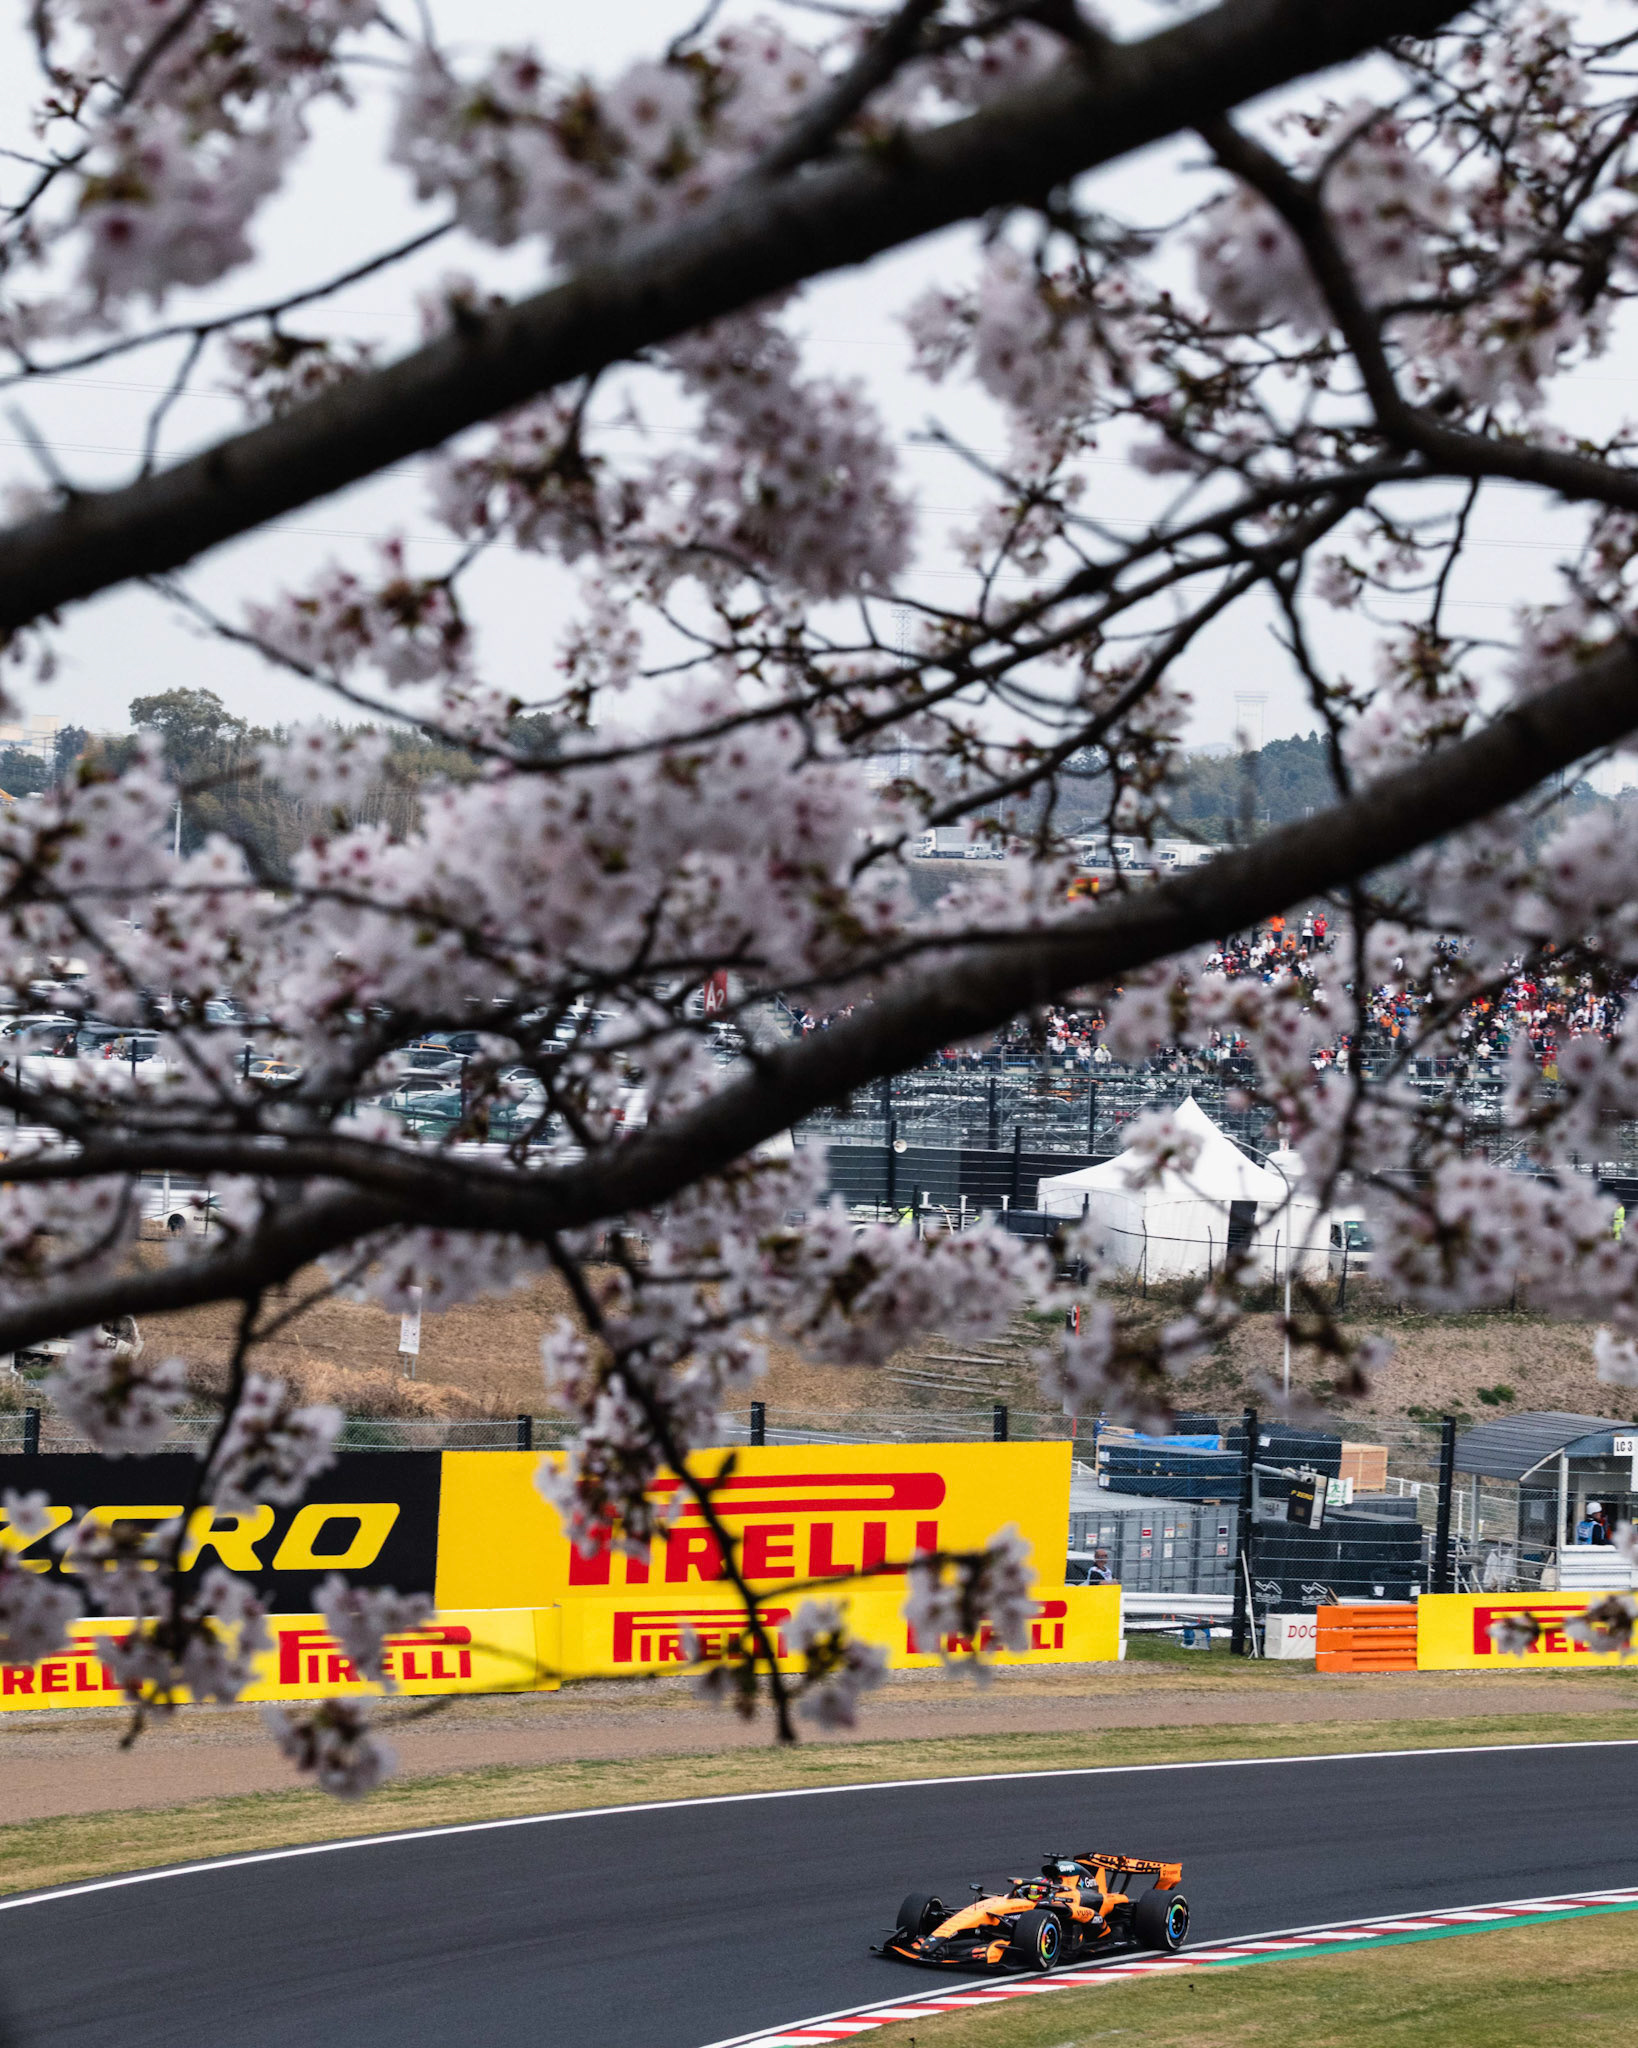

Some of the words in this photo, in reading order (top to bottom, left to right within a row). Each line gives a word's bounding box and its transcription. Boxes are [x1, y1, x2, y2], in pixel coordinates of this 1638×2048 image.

[706, 980, 725, 1012] A2
[1627, 1441, 1633, 1452] 3
[906, 1600, 1068, 1654] RELI
